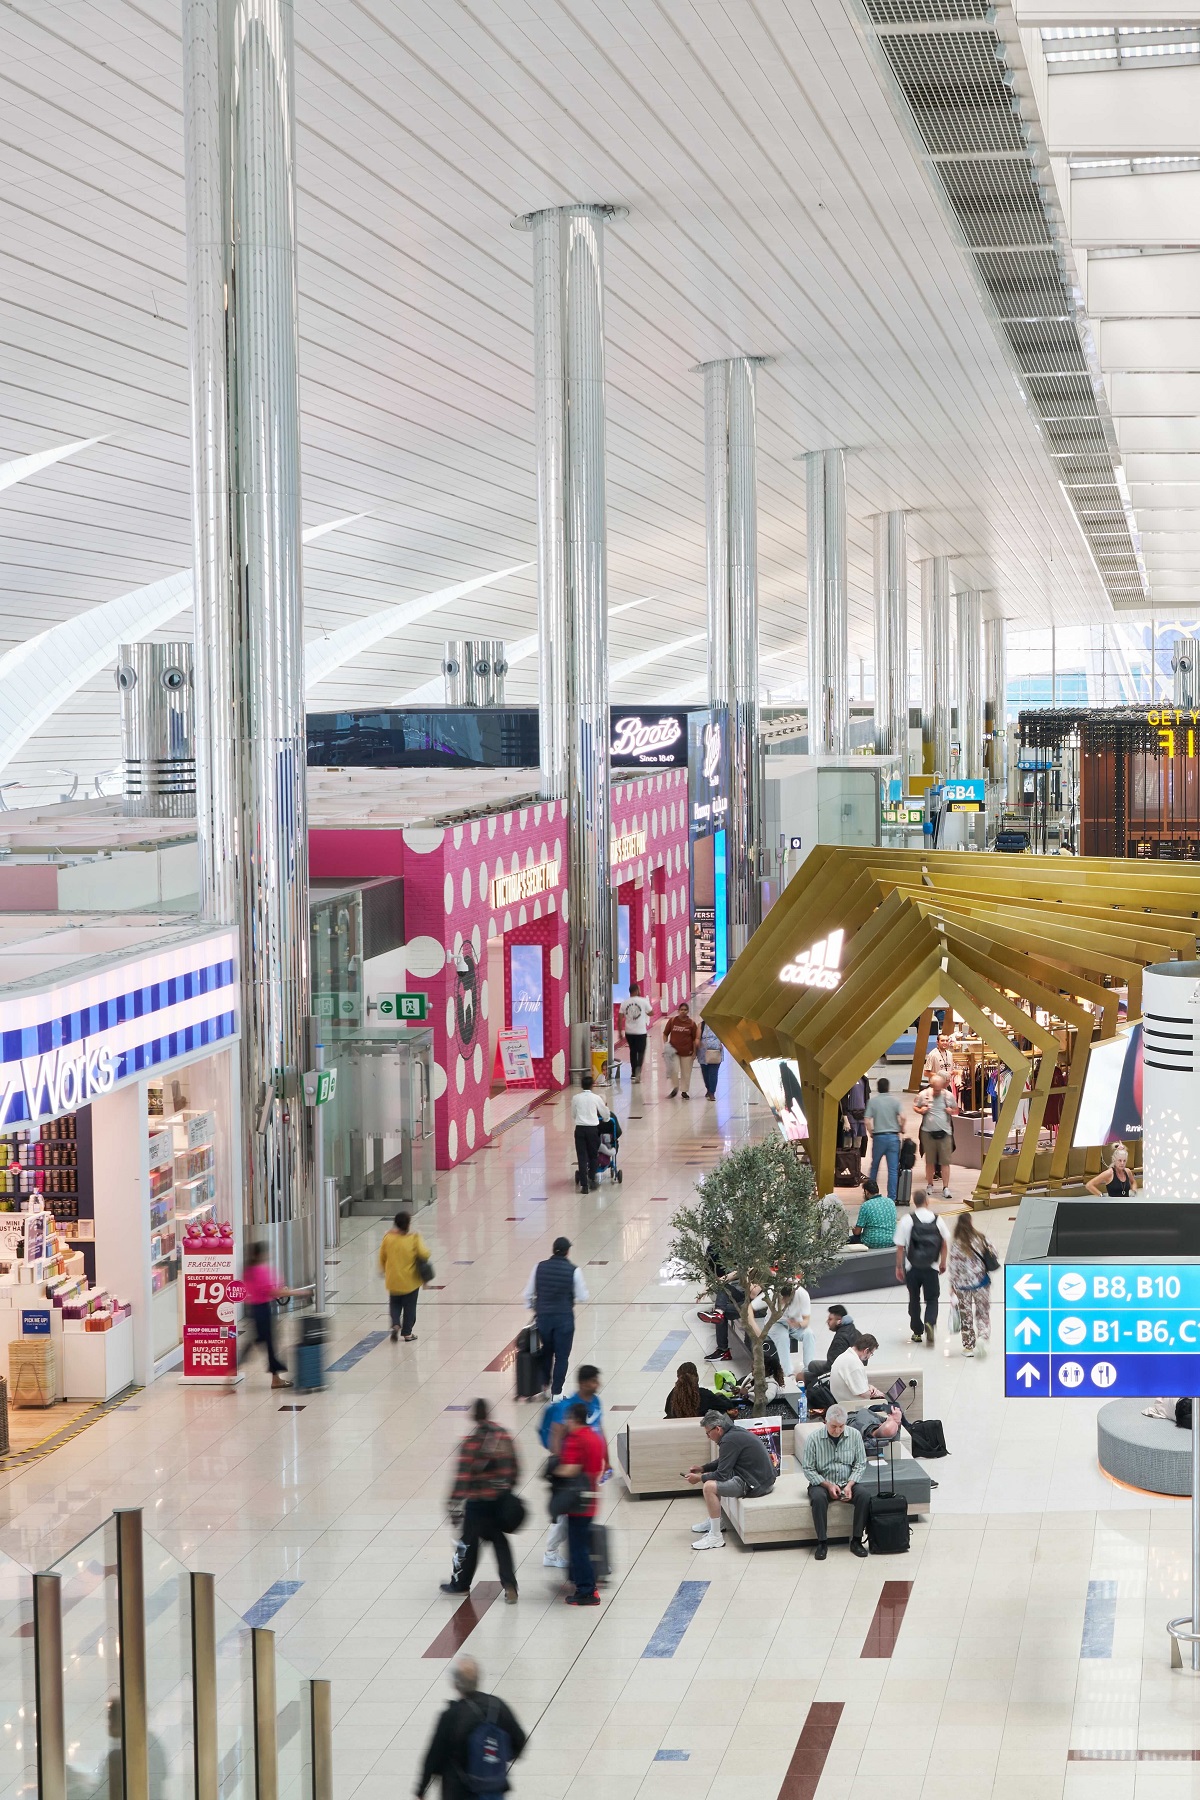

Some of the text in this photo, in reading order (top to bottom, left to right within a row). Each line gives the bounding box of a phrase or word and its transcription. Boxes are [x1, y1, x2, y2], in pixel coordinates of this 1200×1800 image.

[1148, 709, 1183, 726] GET
[610, 717, 681, 756] Boots
[639, 754, 675, 762] Since 1849
[955, 786, 975, 799] B4
[779, 963, 841, 990] adidas
[514, 990, 541, 1013] Pink
[20, 1039, 114, 1121] Works
[194, 1282, 225, 1304] 19
[1094, 1275, 1181, 1302] B8, B10
[192, 1353, 229, 1366] FREE
